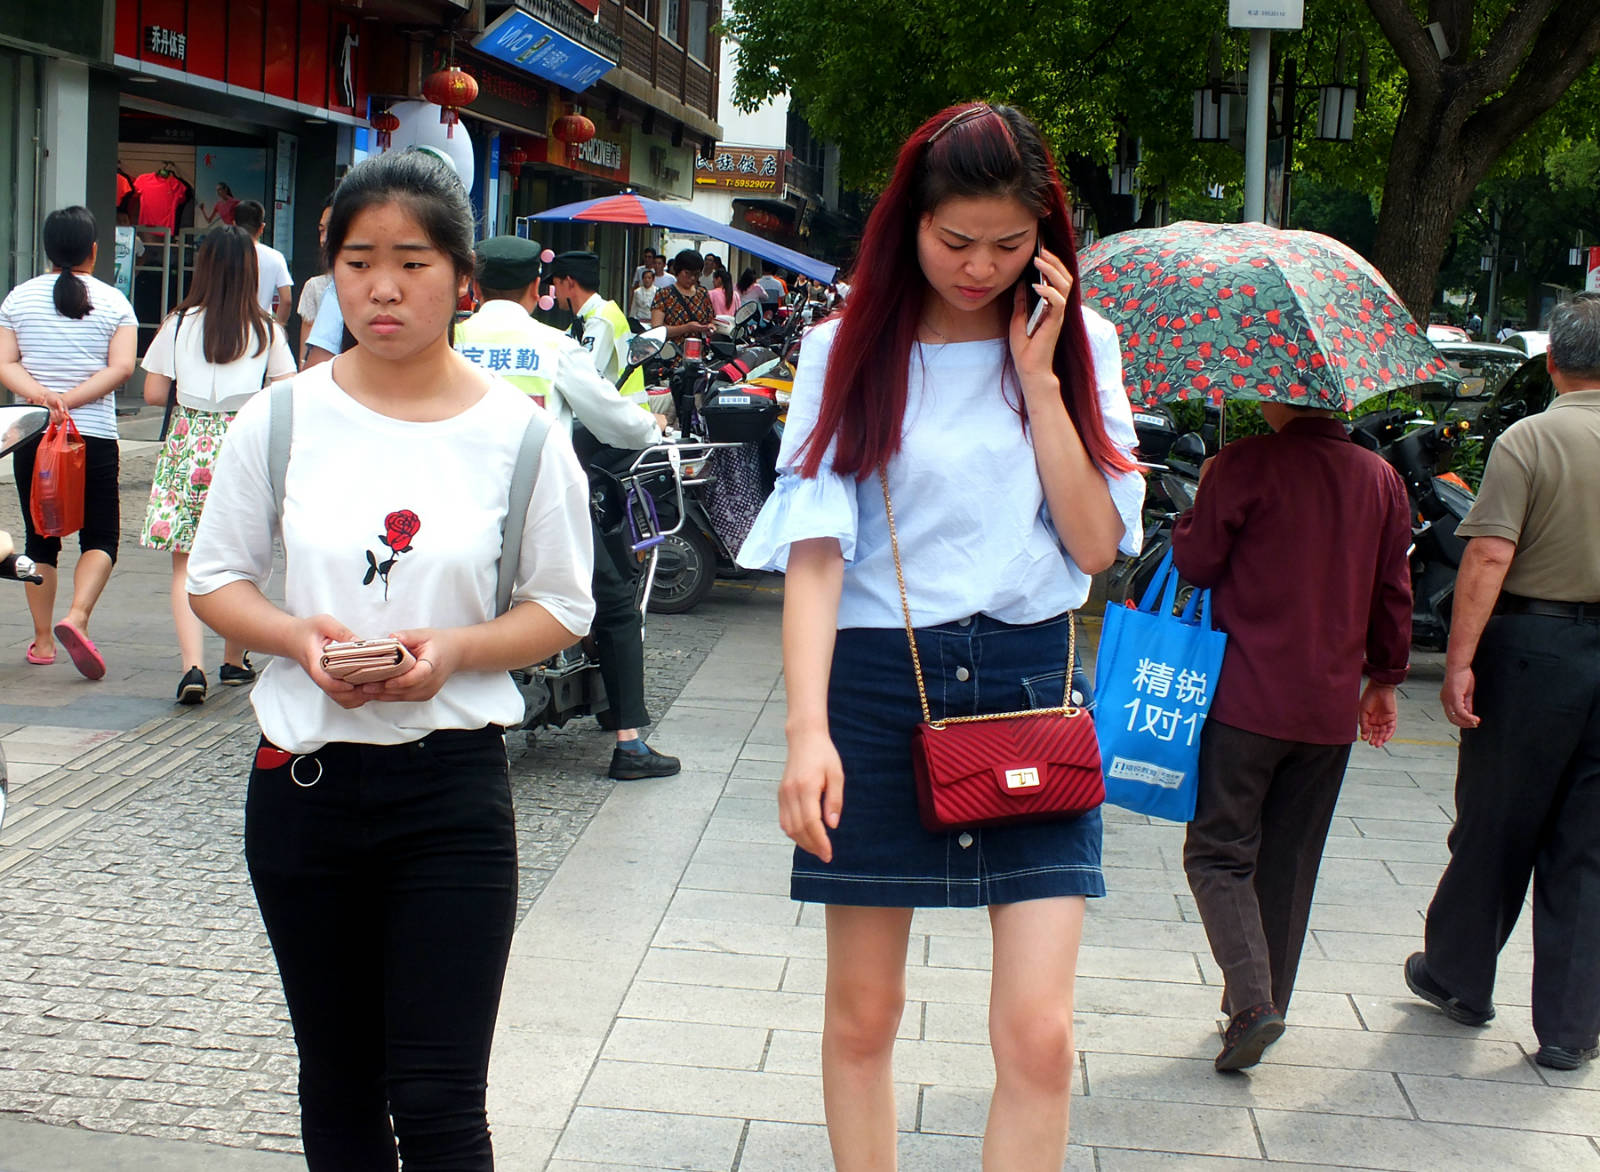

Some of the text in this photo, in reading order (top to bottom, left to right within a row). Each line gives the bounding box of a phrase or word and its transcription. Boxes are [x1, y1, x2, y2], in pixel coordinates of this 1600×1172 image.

[152, 25, 186, 60] 乔丹体育
[695, 153, 777, 176] 民族饭店
[1131, 657, 1207, 706] 精锐
[1123, 697, 1198, 746] 1对1
